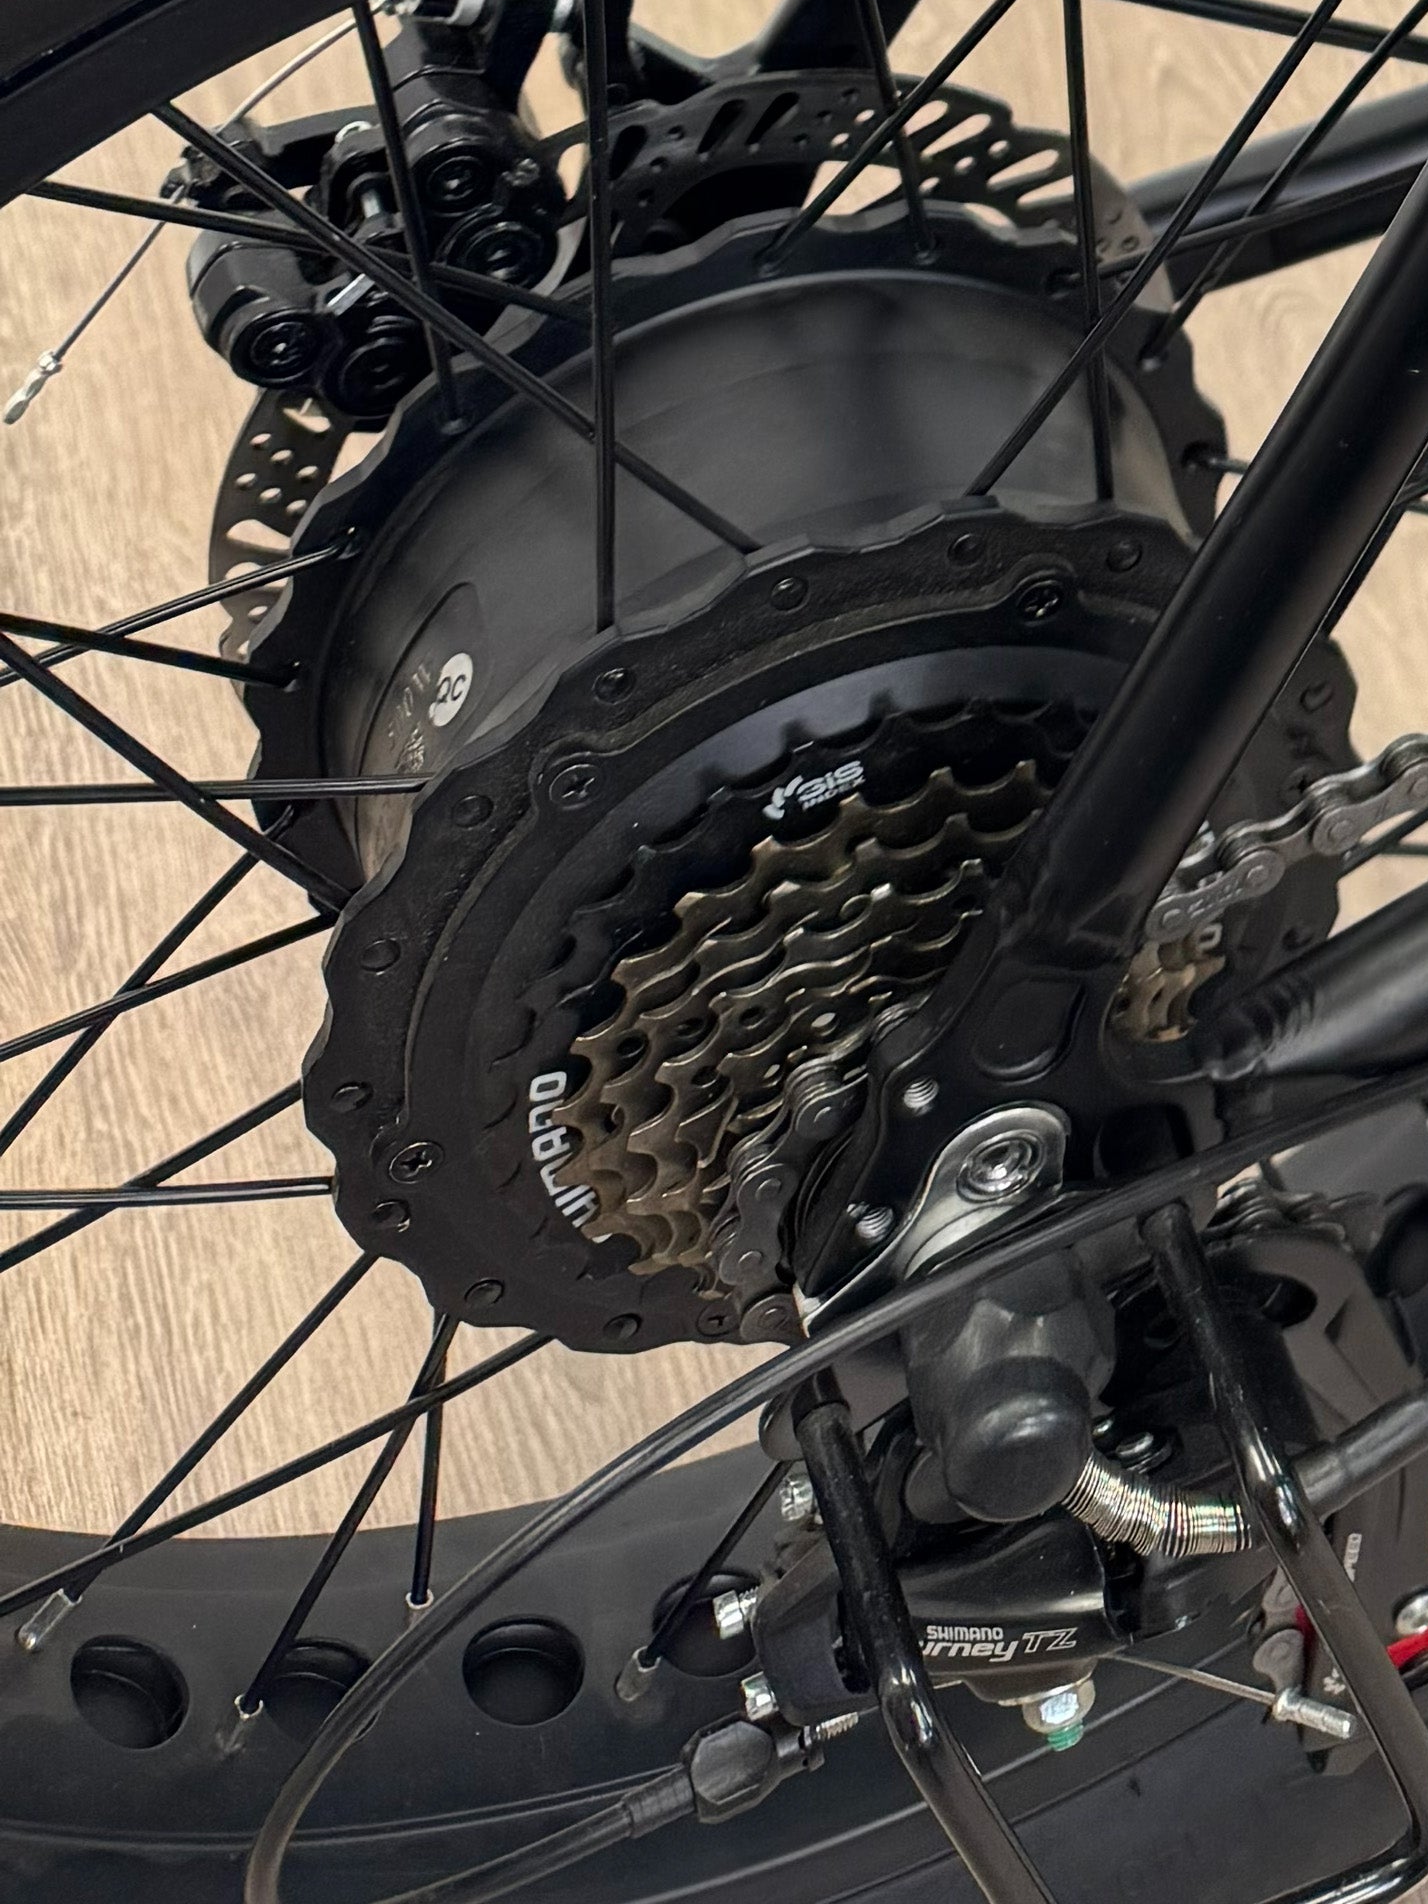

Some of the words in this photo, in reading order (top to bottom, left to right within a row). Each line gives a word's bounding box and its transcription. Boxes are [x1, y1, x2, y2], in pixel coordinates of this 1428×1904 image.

[436, 674, 467, 704] QC
[529, 1071, 613, 1243] HIMANO
[918, 1639, 1019, 1663] urney
[1022, 1626, 1079, 1654] TZ
[926, 1625, 1004, 1641] SHIMANO
